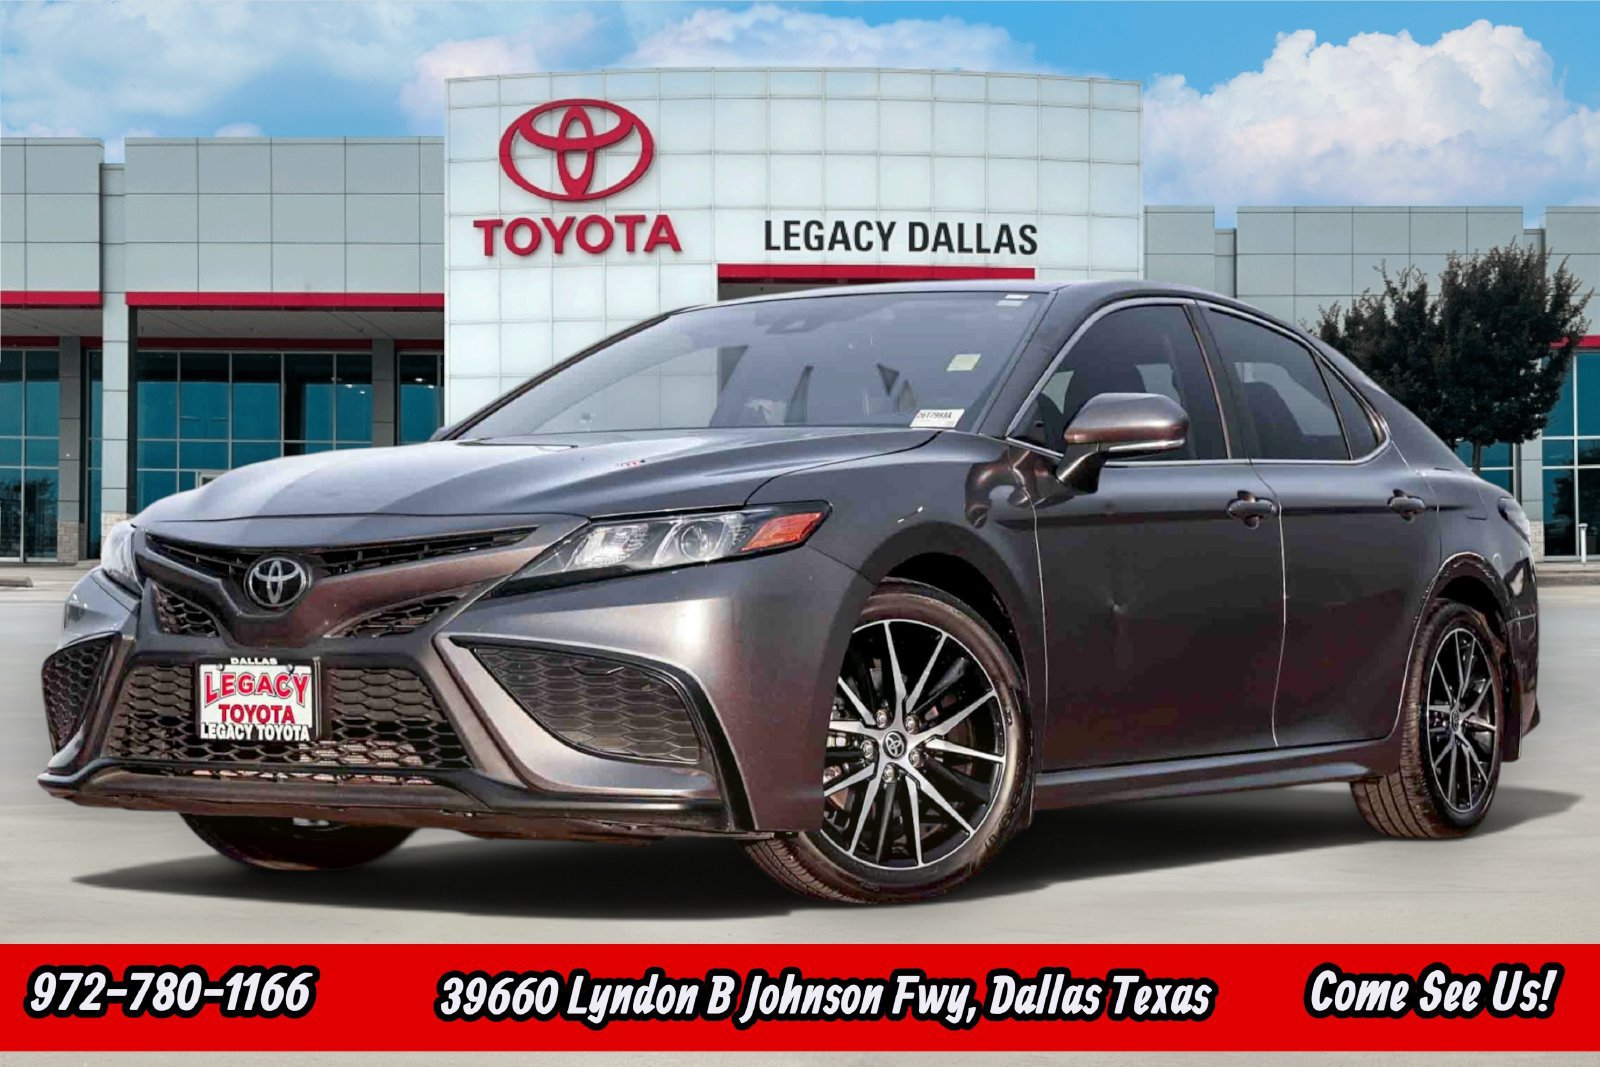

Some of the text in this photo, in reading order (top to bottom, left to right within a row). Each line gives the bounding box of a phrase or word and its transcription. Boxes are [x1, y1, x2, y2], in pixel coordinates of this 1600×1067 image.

[473, 214, 682, 257] TOYOTA
[764, 220, 1038, 255] LEGACY DALLAS
[230, 657, 278, 665] DALLAS
[204, 672, 310, 708] LEGACY
[218, 704, 296, 725] TOYOTA
[201, 722, 311, 742] LEGACY TOYOTA
